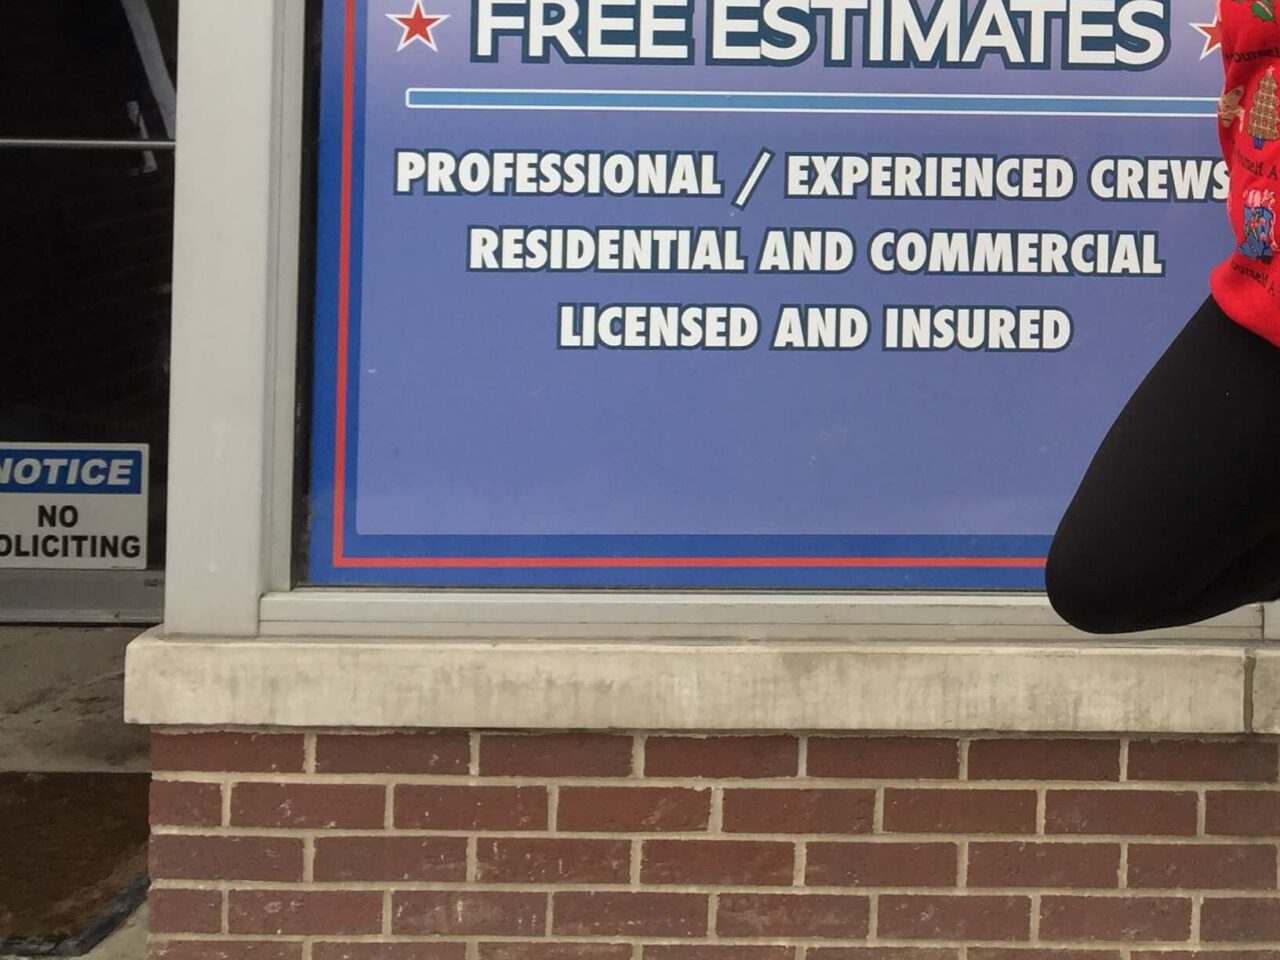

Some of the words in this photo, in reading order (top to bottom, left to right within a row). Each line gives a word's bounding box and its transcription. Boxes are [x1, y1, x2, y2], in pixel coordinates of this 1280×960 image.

[397, 151, 722, 196] PROFESSIONAL
[787, 154, 1075, 200] EXPERIENCED
[1090, 157, 1231, 201] CREWS
[1267, 165, 1279, 181] A
[470, 227, 745, 271] RESIDENTIAL
[759, 231, 854, 272] AND
[869, 232, 1163, 275] COMMERCIAL
[560, 305, 759, 349] LICENSED
[774, 307, 870, 350] AND
[885, 308, 1073, 351] INSURED
[38, 504, 79, 528] NO
[0, 534, 141, 559] OLICITING
